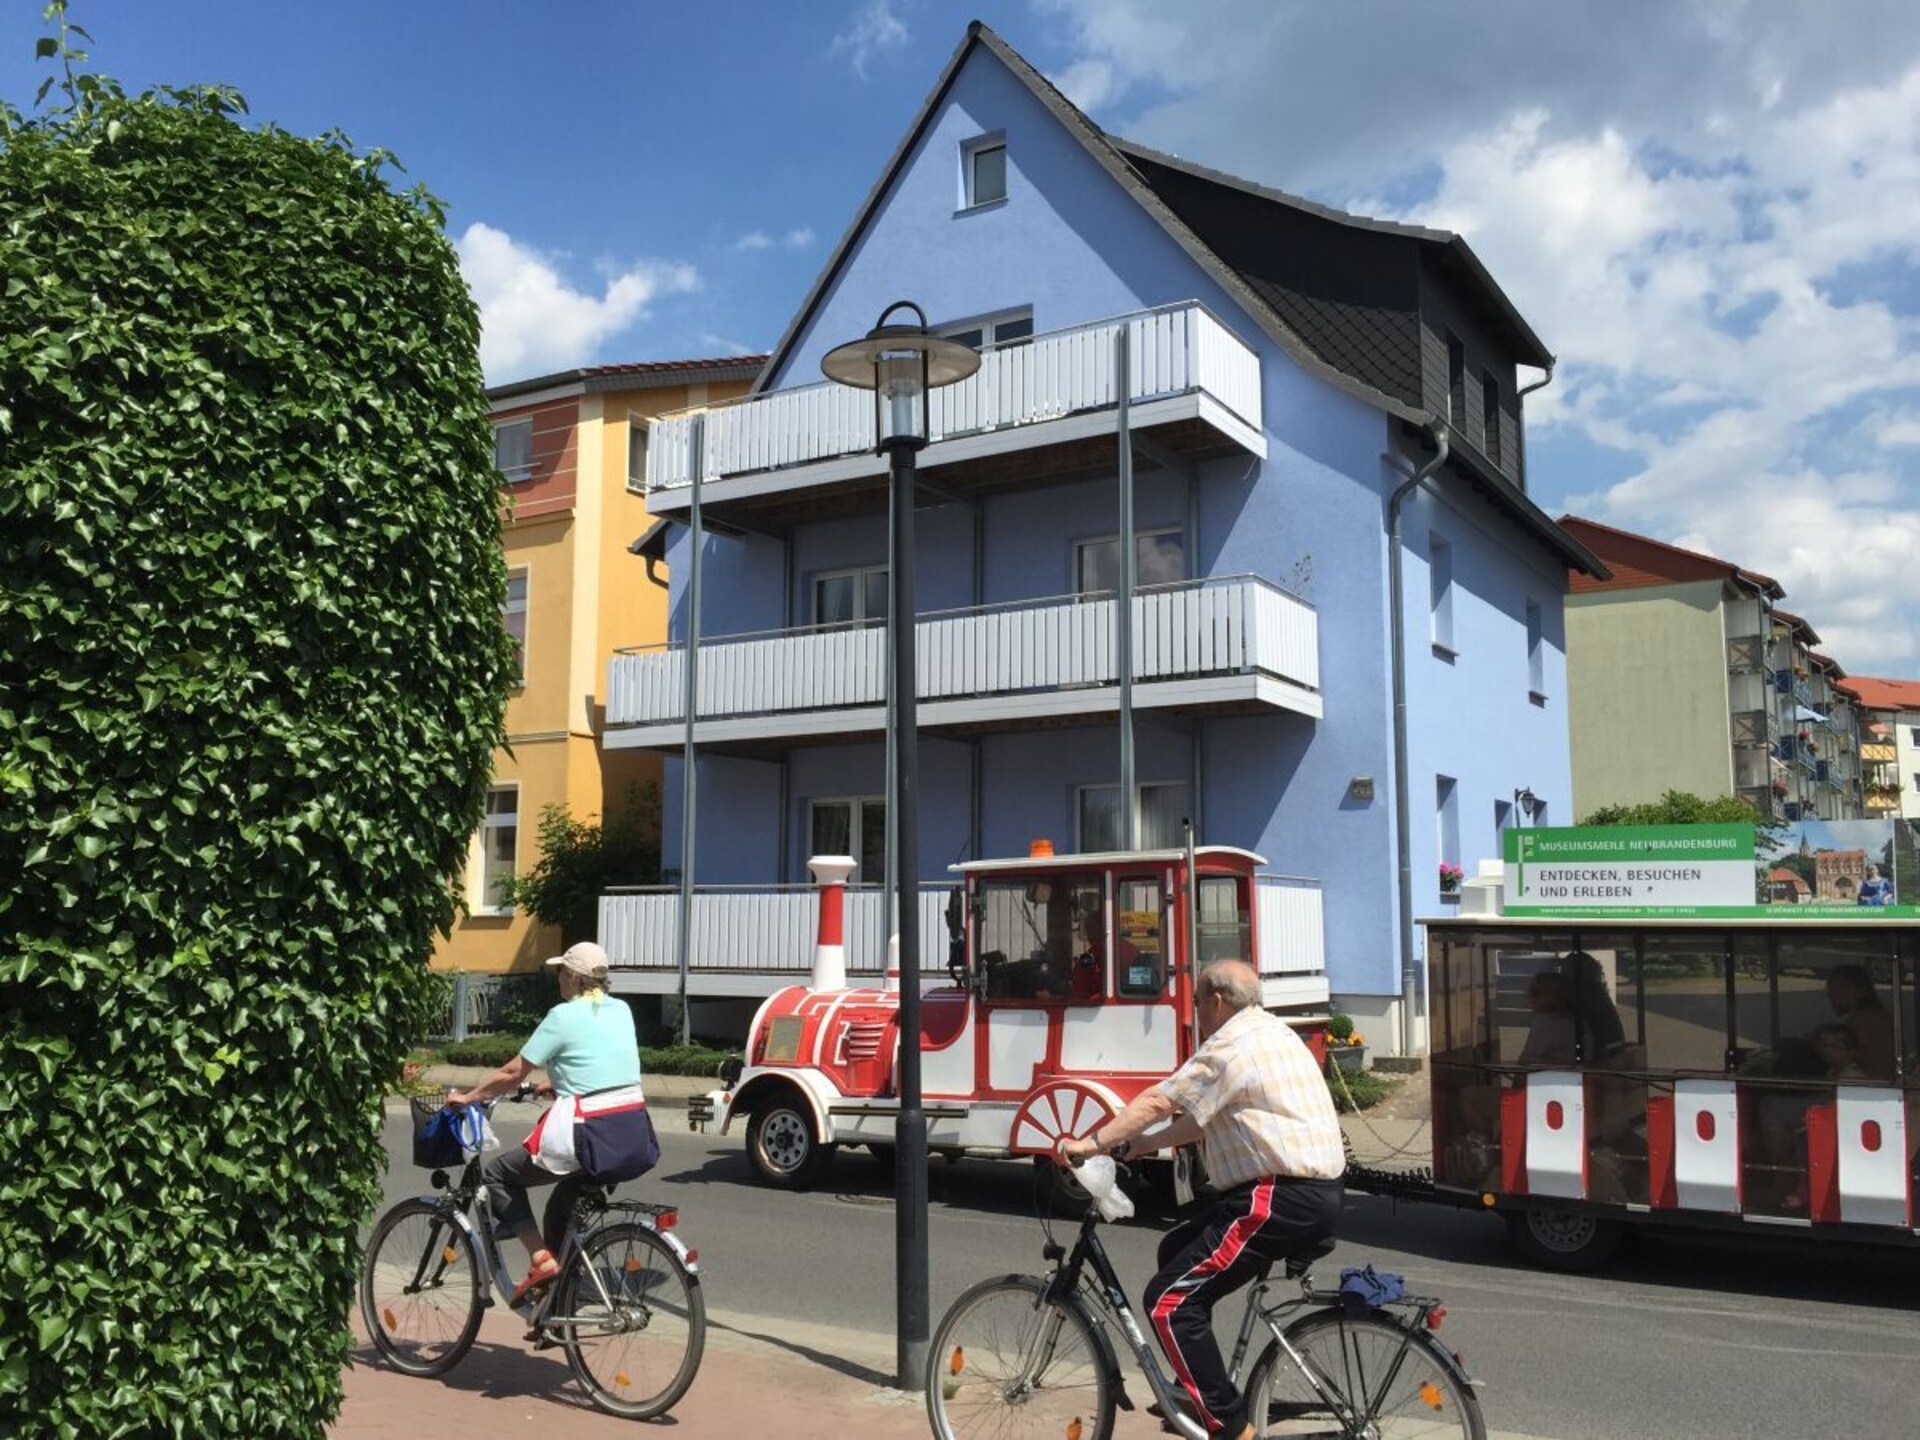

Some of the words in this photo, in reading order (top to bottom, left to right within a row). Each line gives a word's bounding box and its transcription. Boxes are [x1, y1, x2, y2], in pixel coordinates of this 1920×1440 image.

[1540, 840, 1626, 851] MUSEUMSMEILE
[1630, 838, 1737, 850] NEUBRANDENBURG
[1540, 869, 1622, 882] ENTDECKEN,
[1627, 868, 1702, 881] BESUCHEN
[1540, 886, 1568, 898] UND
[1573, 885, 1632, 898] ERLEBEN
